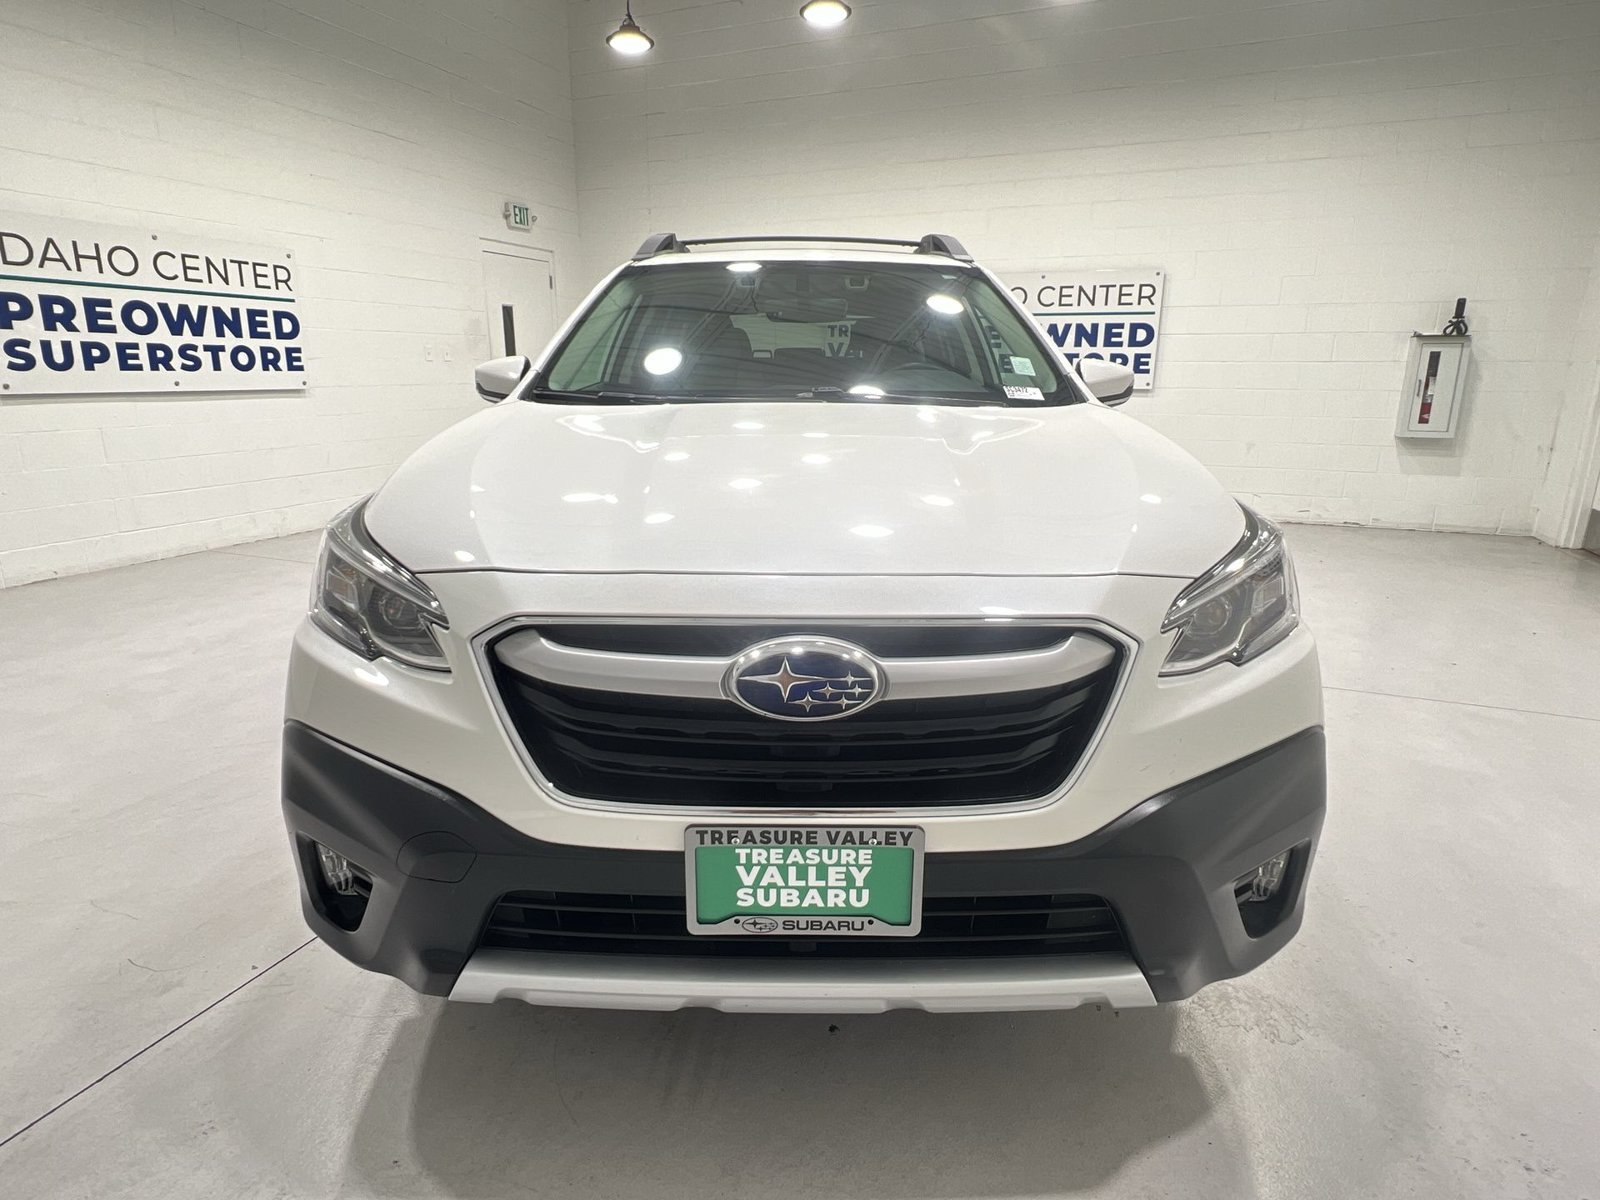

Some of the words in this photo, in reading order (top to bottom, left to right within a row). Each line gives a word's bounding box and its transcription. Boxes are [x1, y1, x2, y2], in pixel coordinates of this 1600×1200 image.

[513, 205, 529, 226] EXIT
[152, 250, 293, 291] CENTER
[1037, 283, 1157, 307] CENTER
[0, 291, 301, 340] PREOWNED
[3, 338, 305, 372] SUPERSTORE
[695, 829, 818, 846] TREASURE
[826, 830, 914, 846] VALLEY
[735, 848, 873, 865] TREASURE
[735, 866, 872, 887] VALLEY
[735, 888, 870, 908] SUBARU
[782, 919, 865, 931] SUBARU
